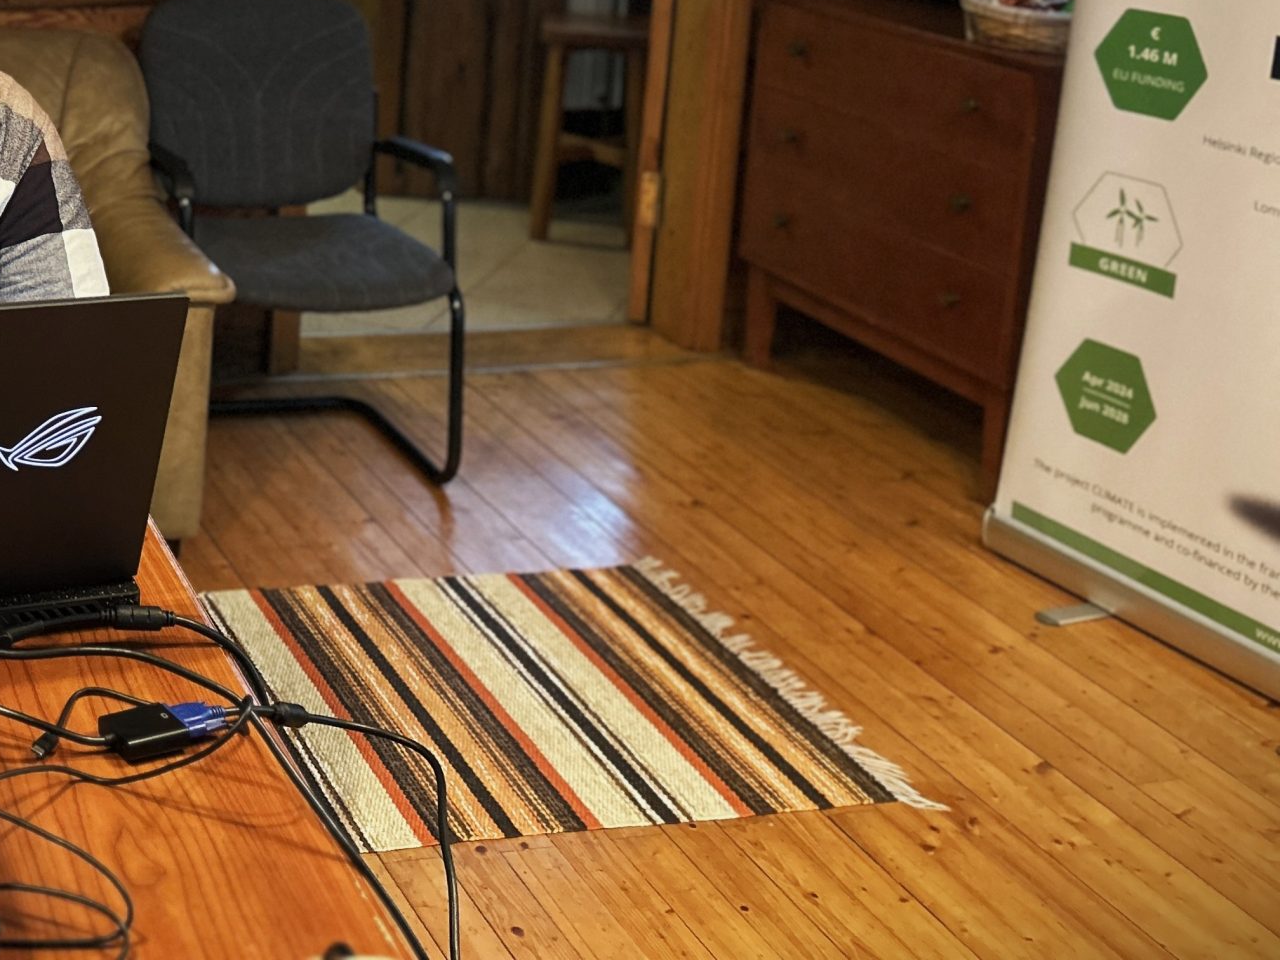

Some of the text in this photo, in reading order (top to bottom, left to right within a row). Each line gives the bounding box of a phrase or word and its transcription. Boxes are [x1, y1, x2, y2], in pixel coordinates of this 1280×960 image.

[1128, 44, 1179, 67] 1.46 M
[1112, 68, 1185, 94] EU FUNDING
[1098, 256, 1149, 283] GREEN
[1082, 370, 1104, 387] Apr
[1154, 534, 1174, 549] and
[1243, 574, 1259, 591] by
[1223, 546, 1234, 560] in
[1236, 553, 1256, 570] the
